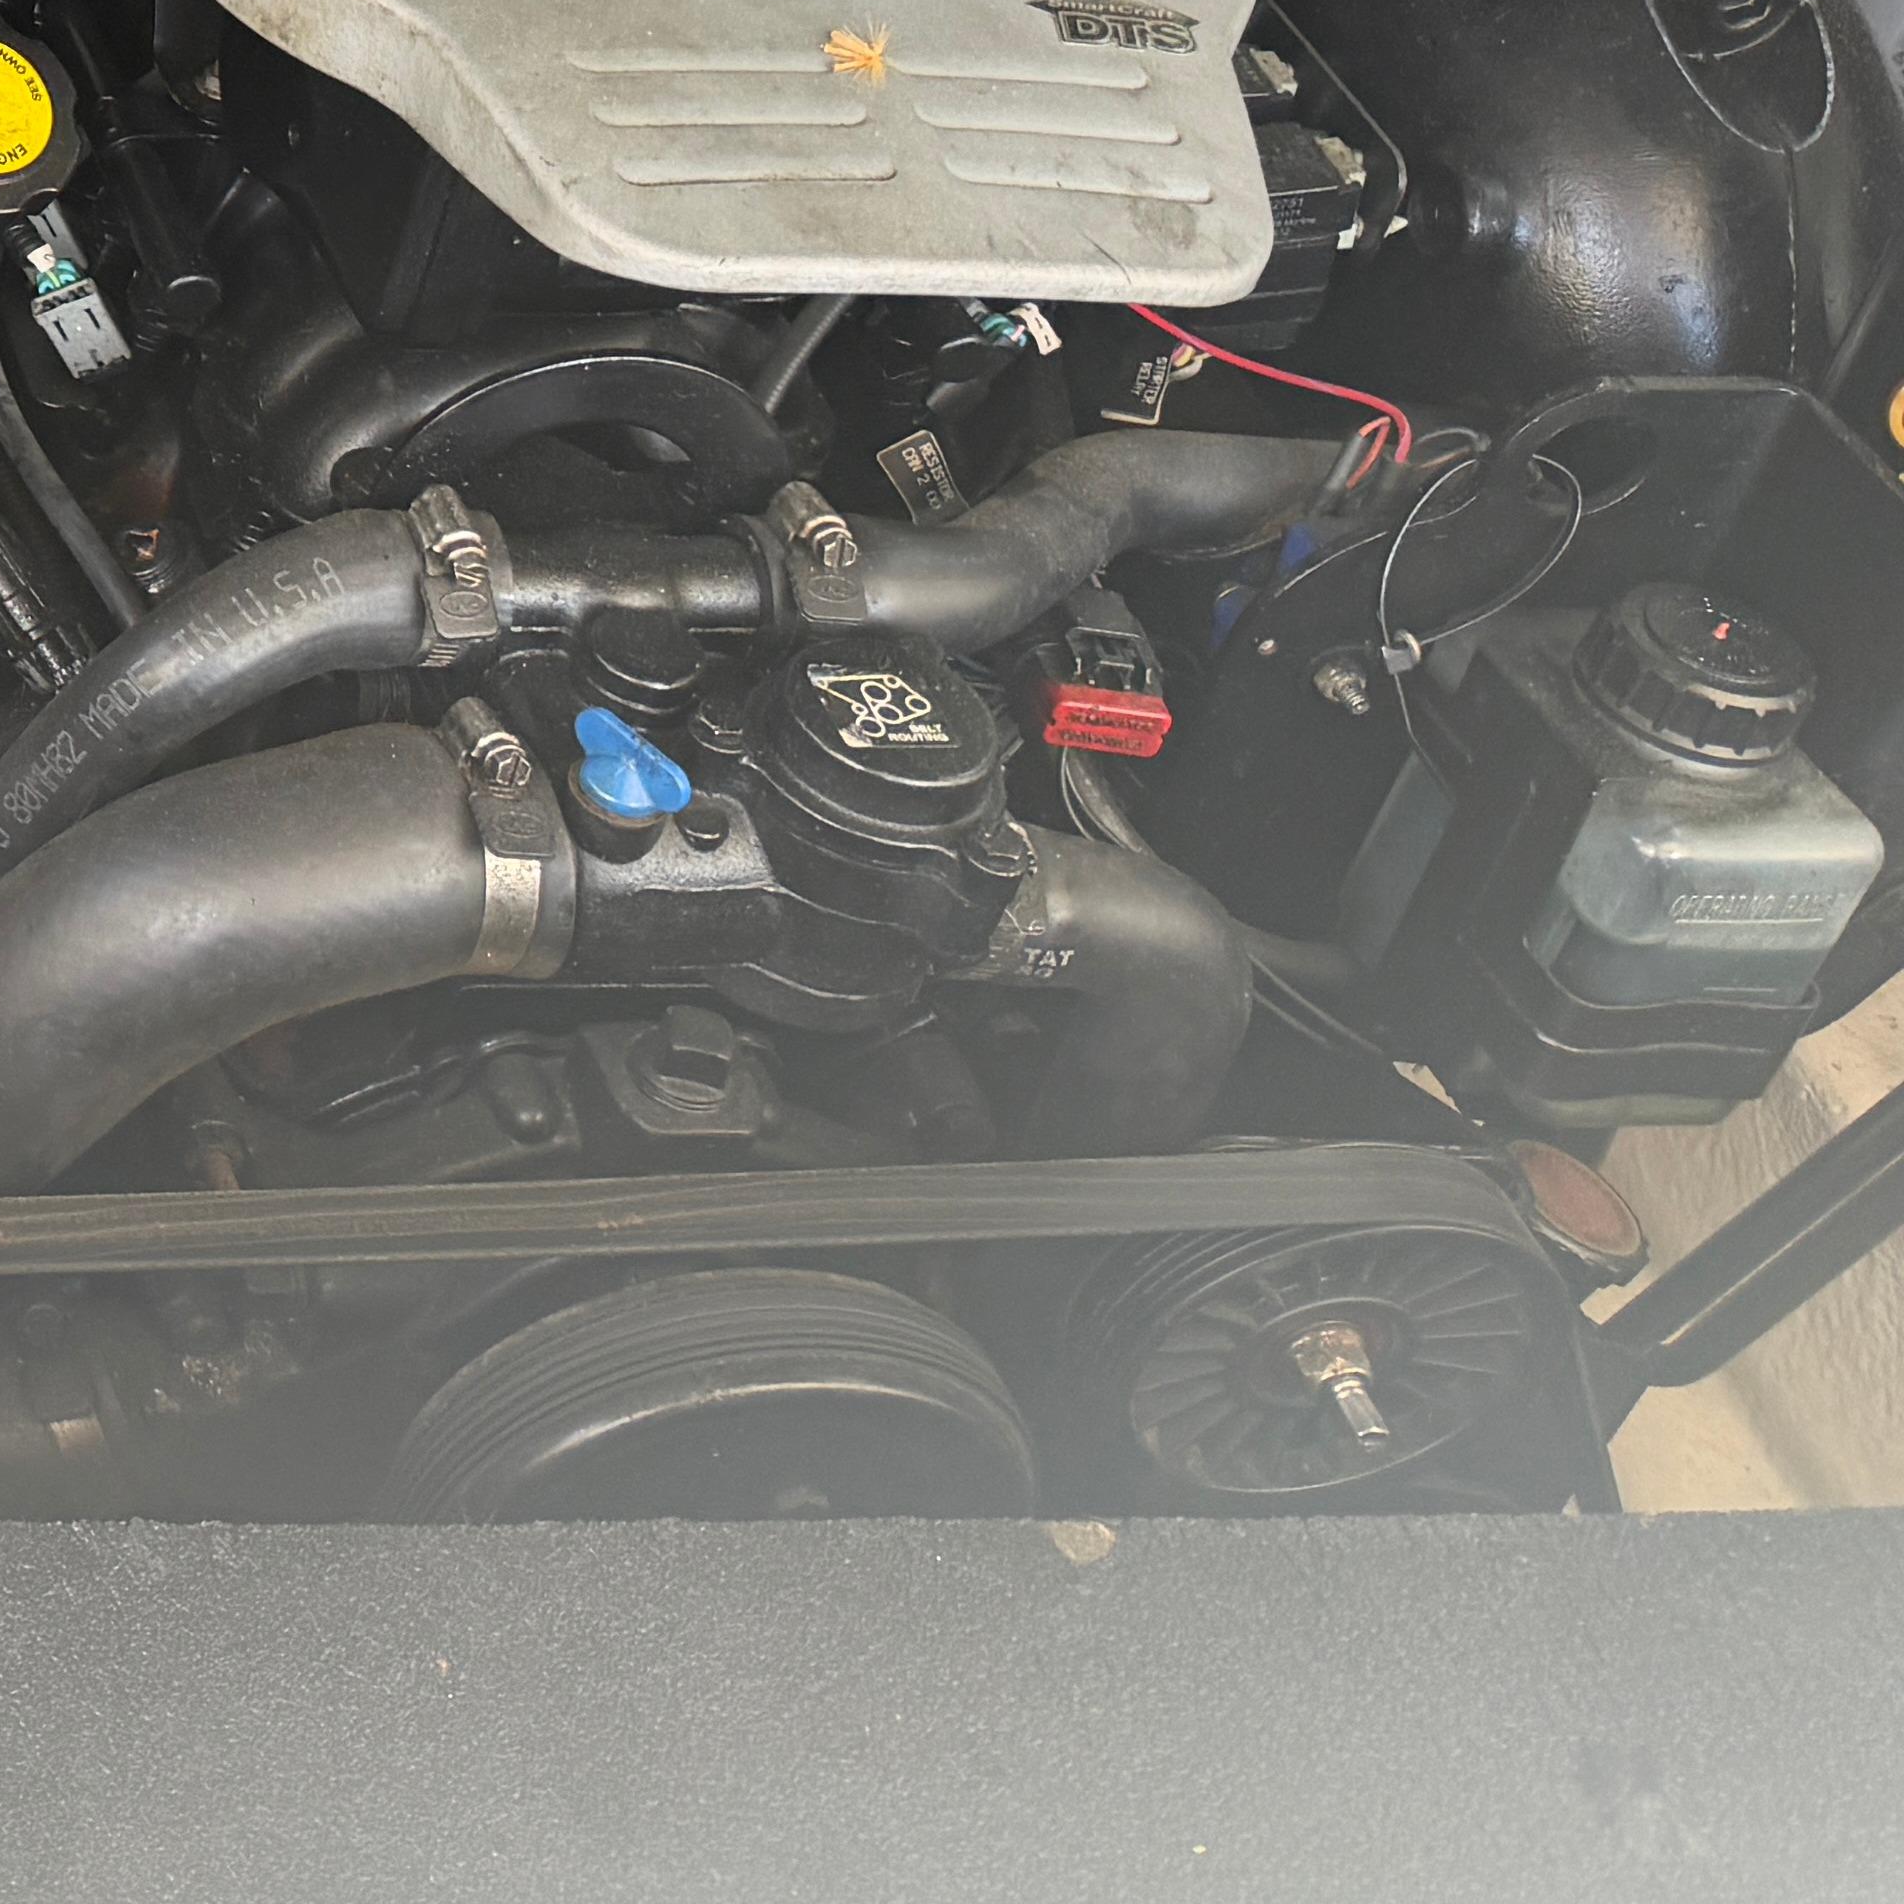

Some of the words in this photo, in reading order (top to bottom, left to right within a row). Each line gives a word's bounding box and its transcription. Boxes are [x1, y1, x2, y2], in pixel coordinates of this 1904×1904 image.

[1058, 11, 1194, 53] DTS
[25, 77, 42, 102] SEE
[902, 447, 924, 472] CAN
[78, 658, 162, 740] MADE
[171, 612, 234, 666] IN
[888, 733, 949, 742] ROUTING
[909, 723, 941, 733] BELT
